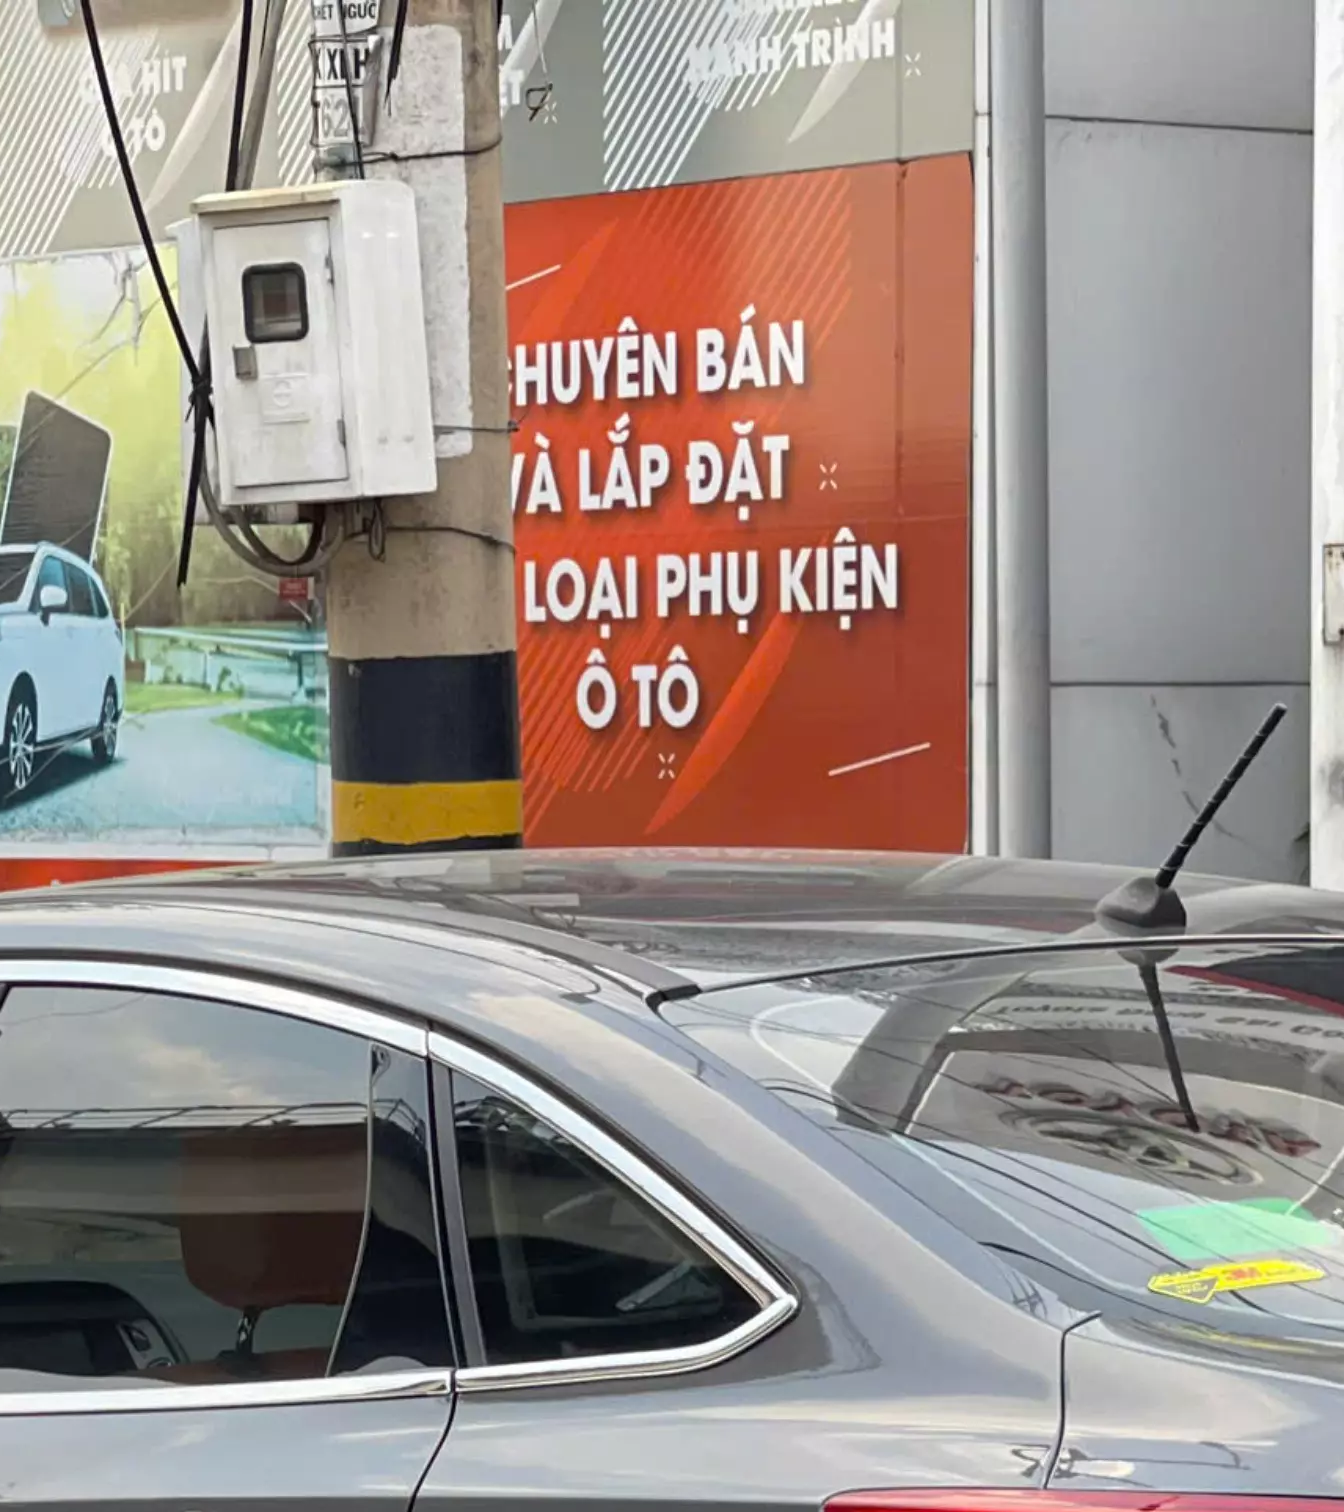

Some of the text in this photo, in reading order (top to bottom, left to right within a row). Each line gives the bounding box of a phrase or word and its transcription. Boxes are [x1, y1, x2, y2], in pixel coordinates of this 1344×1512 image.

[507, 304, 804, 407] HUYÊN BÁN
[579, 412, 670, 512] LẮP
[685, 419, 790, 521] ĐẶT
[524, 526, 898, 639] LOẠI PHỤ KIỆN
[576, 644, 699, 729] Ô TÔ
